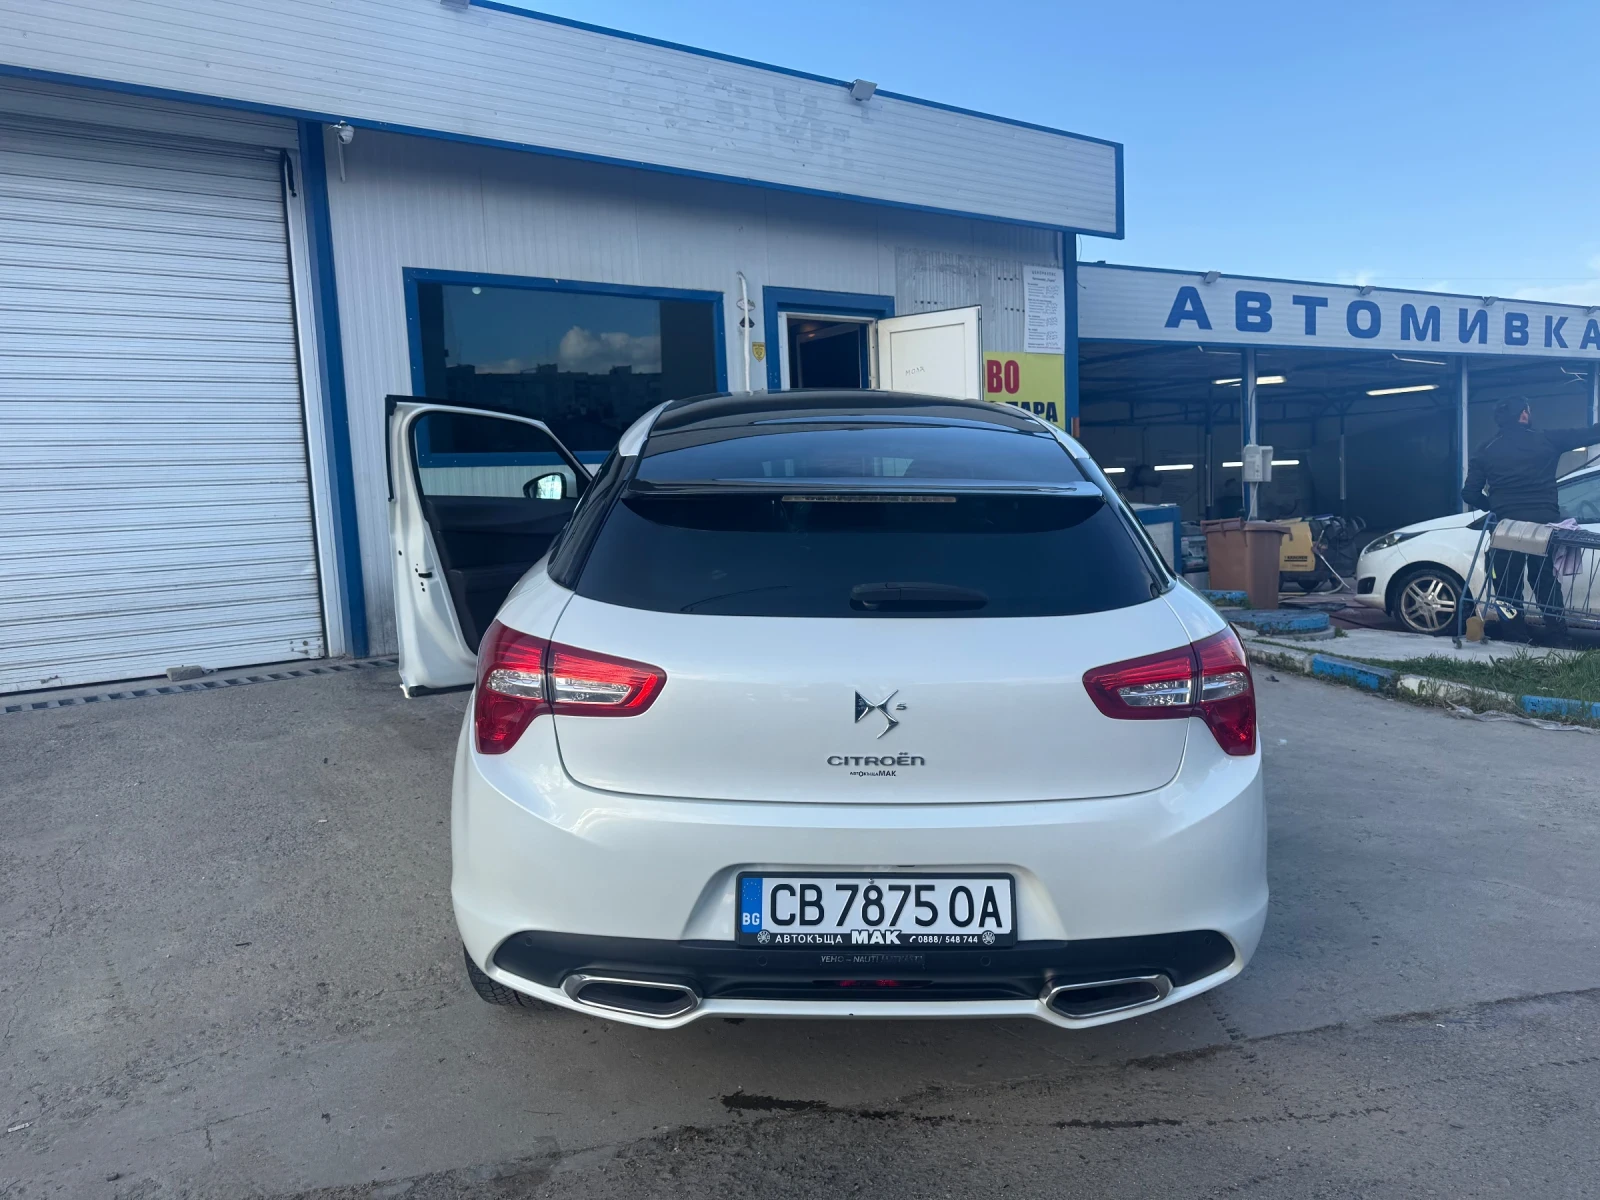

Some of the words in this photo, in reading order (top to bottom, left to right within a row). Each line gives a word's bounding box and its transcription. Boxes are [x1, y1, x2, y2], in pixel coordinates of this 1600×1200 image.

[1164, 285, 1600, 350] АВТОМИВКА
[742, 913, 760, 925] BG
[770, 883, 825, 927] CB
[835, 884, 939, 927] 7875
[775, 934, 843, 945] АВТОКЪЩА
[851, 929, 901, 945] МАК
[918, 934, 943, 944] 0888/
[945, 935, 960, 944] 548
[961, 935, 978, 944] 744
